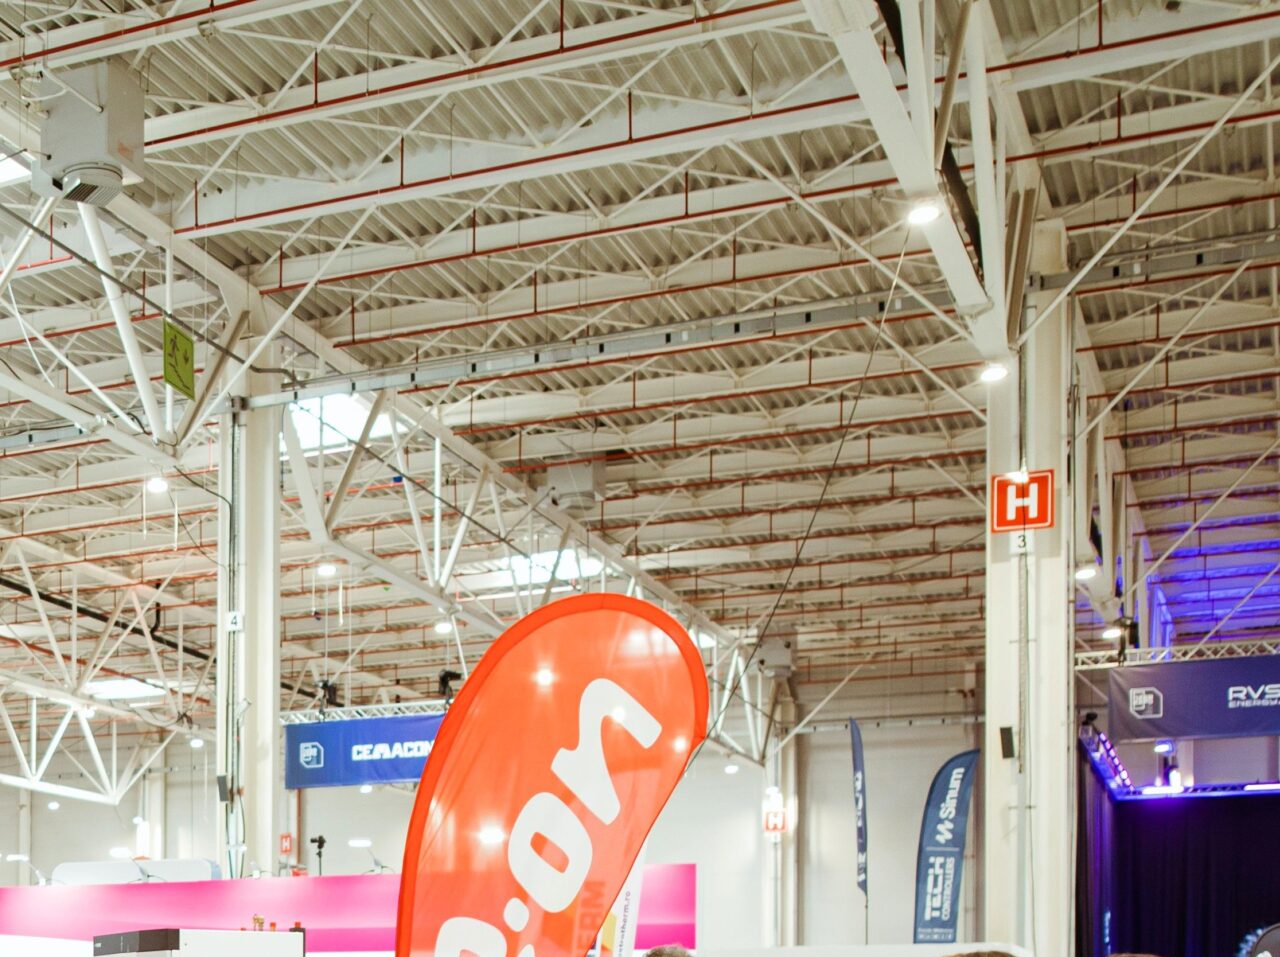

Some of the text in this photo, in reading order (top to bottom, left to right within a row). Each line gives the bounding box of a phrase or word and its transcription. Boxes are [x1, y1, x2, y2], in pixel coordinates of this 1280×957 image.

[1006, 483, 1038, 521] H
[1017, 534, 1027, 549] 3
[939, 767, 965, 820] Sinum
[941, 856, 956, 921] CONTROLLERS
